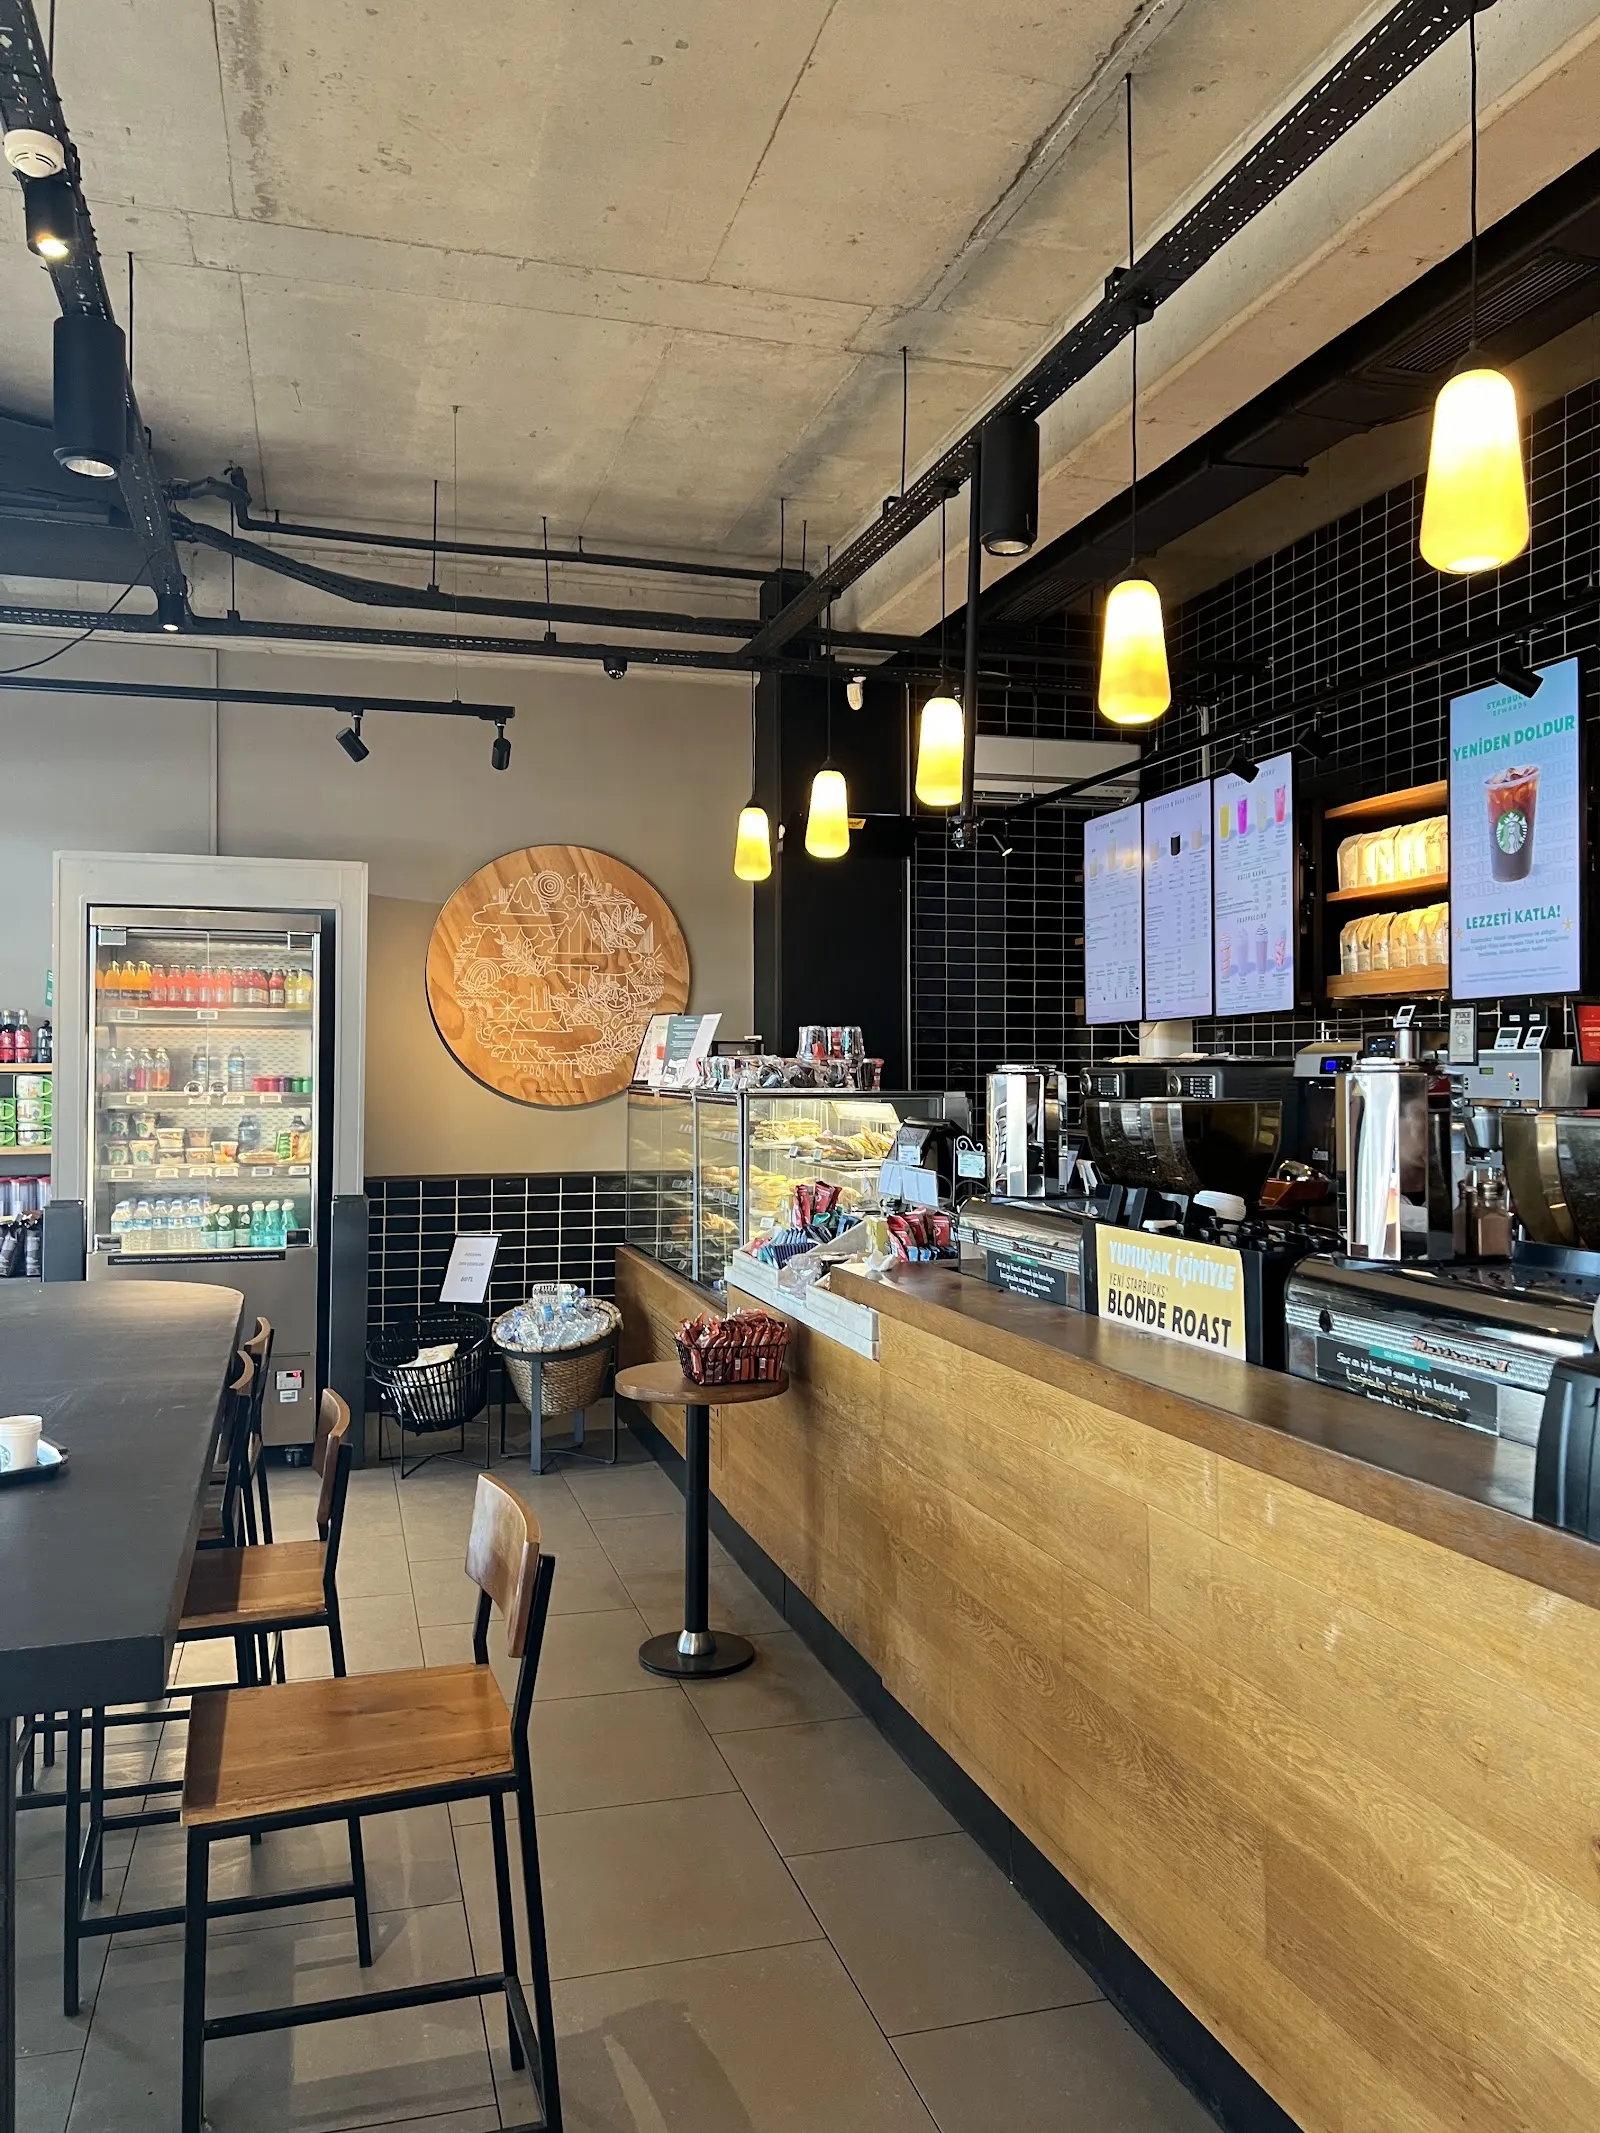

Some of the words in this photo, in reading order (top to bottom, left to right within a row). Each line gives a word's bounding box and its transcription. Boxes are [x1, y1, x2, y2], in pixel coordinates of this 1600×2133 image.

[1453, 733, 1511, 761] YENİDEN
[1514, 714, 1575, 746] DOLDUR
[1466, 908, 1511, 930] LEZZETİ
[1514, 904, 1561, 923] KATLA!
[1108, 1272, 1125, 1288] YENİ
[1109, 1240, 1172, 1279] YUMUŞAK
[1175, 1248, 1236, 1291] İÇİMİYLE
[1107, 1288, 1167, 1329] BLONDE
[1171, 1305, 1232, 1348] ROAST
